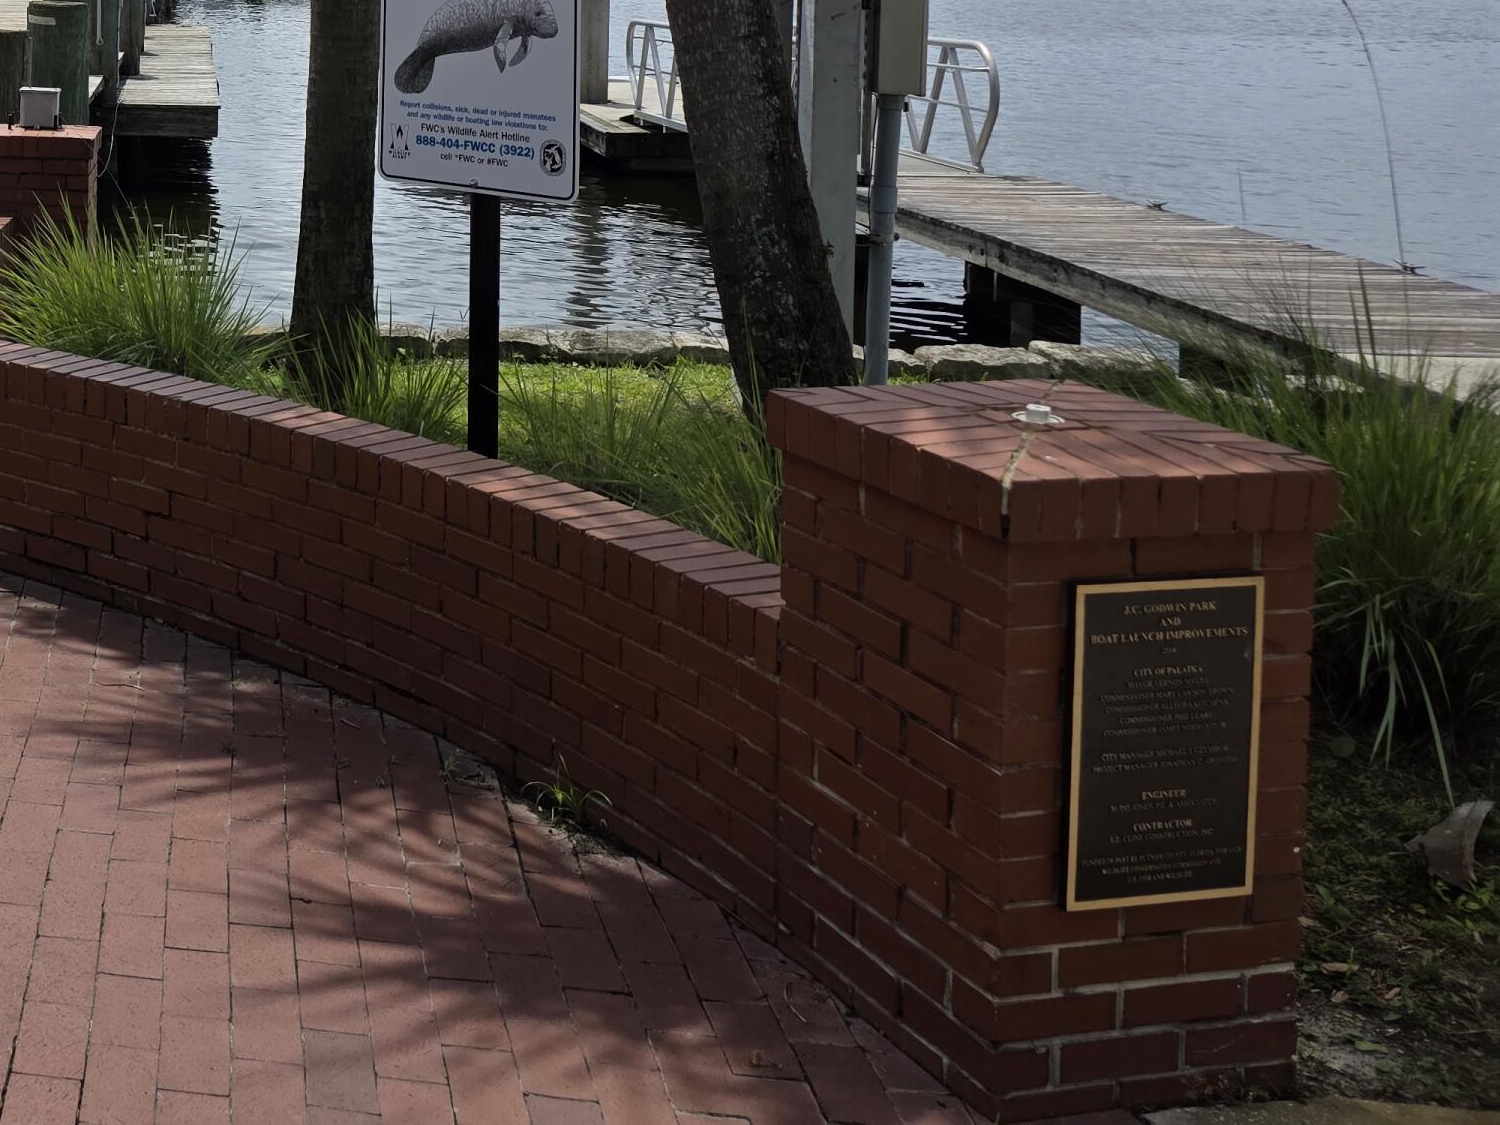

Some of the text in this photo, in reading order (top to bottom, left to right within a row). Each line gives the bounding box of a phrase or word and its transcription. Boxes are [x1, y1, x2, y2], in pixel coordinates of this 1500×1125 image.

[399, 100, 421, 109] Report
[422, 102, 453, 112] collisions,
[455, 106, 471, 114] sick,
[472, 107, 488, 115] dead
[499, 109, 521, 118] injured
[523, 112, 556, 122] manatees
[420, 113, 432, 121] any
[433, 113, 455, 122] wildlife
[465, 116, 490, 126] boating
[491, 119, 503, 127] law
[504, 120, 537, 130] violations
[420, 123, 531, 143] FWC's Wildlife Alert Hotline
[415, 134, 535, 160] 888-404-FWCC (3922)
[440, 152, 452, 161] cell
[486, 156, 509, 167] #FWC
[1144, 602, 1188, 614] GODWIN
[1189, 600, 1217, 611] PARK
[1160, 617, 1181, 627] AND
[1091, 626, 1249, 644] BOAT LAUNCH IMPROVEMENTS
[1134, 665, 1204, 677] CITY OF PALATKA
[1142, 789, 1187, 800] ENGINEER
[1133, 818, 1193, 832] CONTRACTOR
